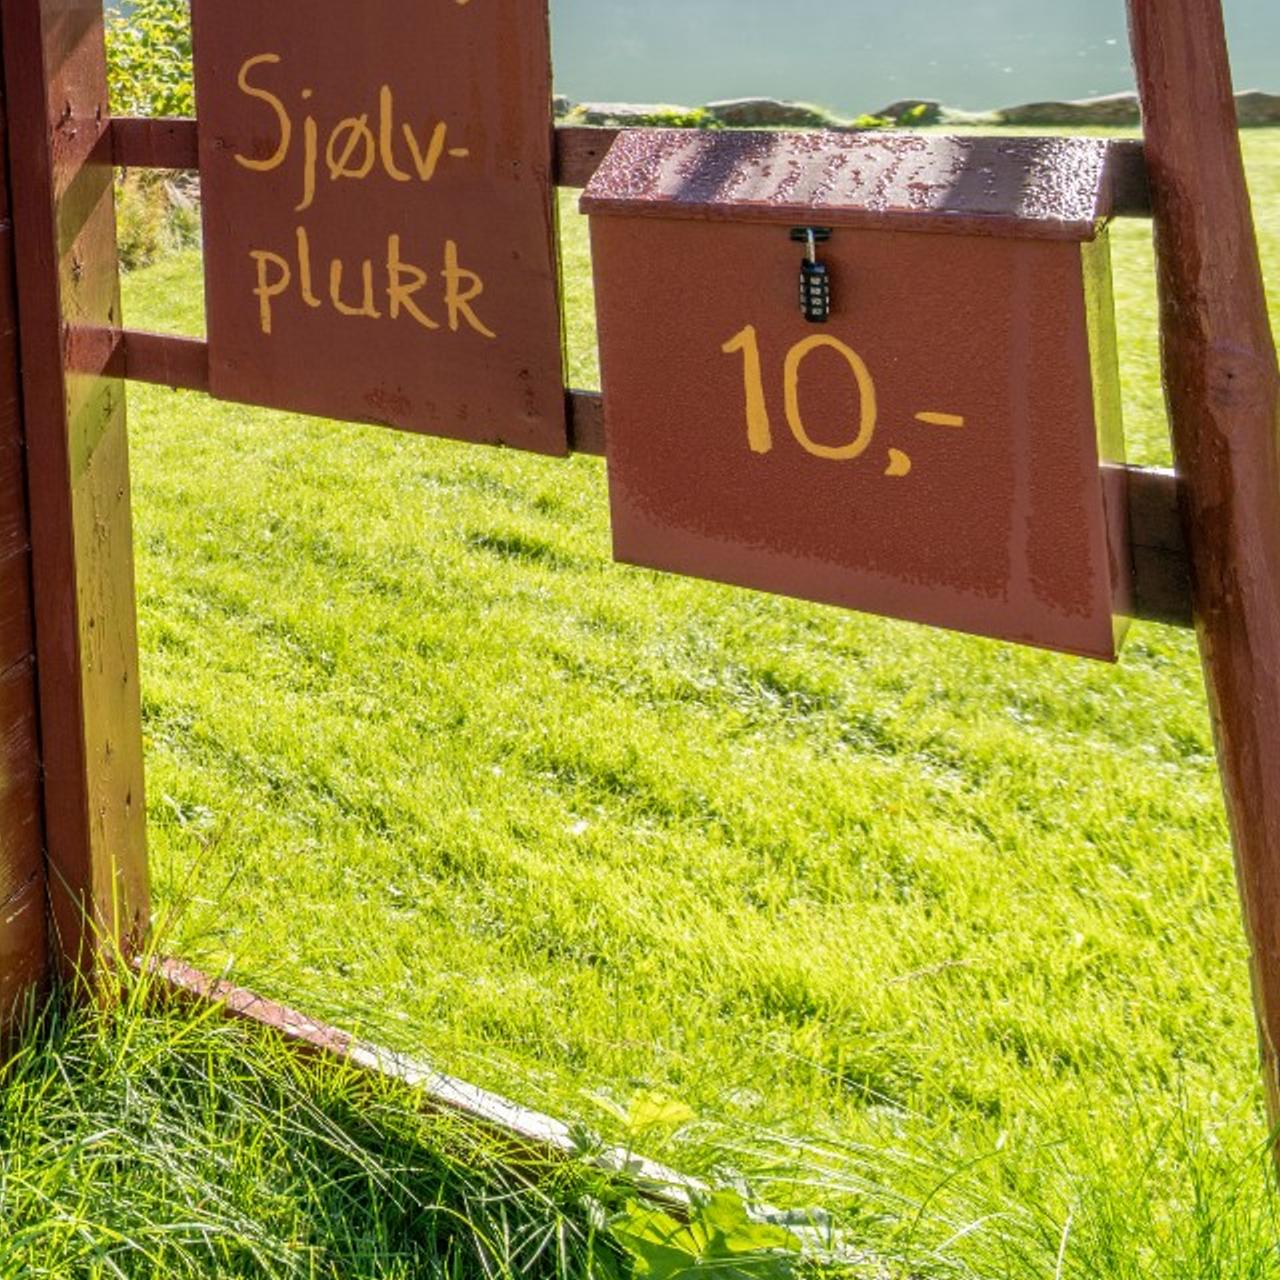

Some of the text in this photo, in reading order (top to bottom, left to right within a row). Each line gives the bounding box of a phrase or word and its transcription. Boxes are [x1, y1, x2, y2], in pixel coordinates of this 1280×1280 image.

[234, 53, 470, 211] Sjølv-
[249, 226, 496, 337] plukk
[721, 324, 965, 477] 10,-
